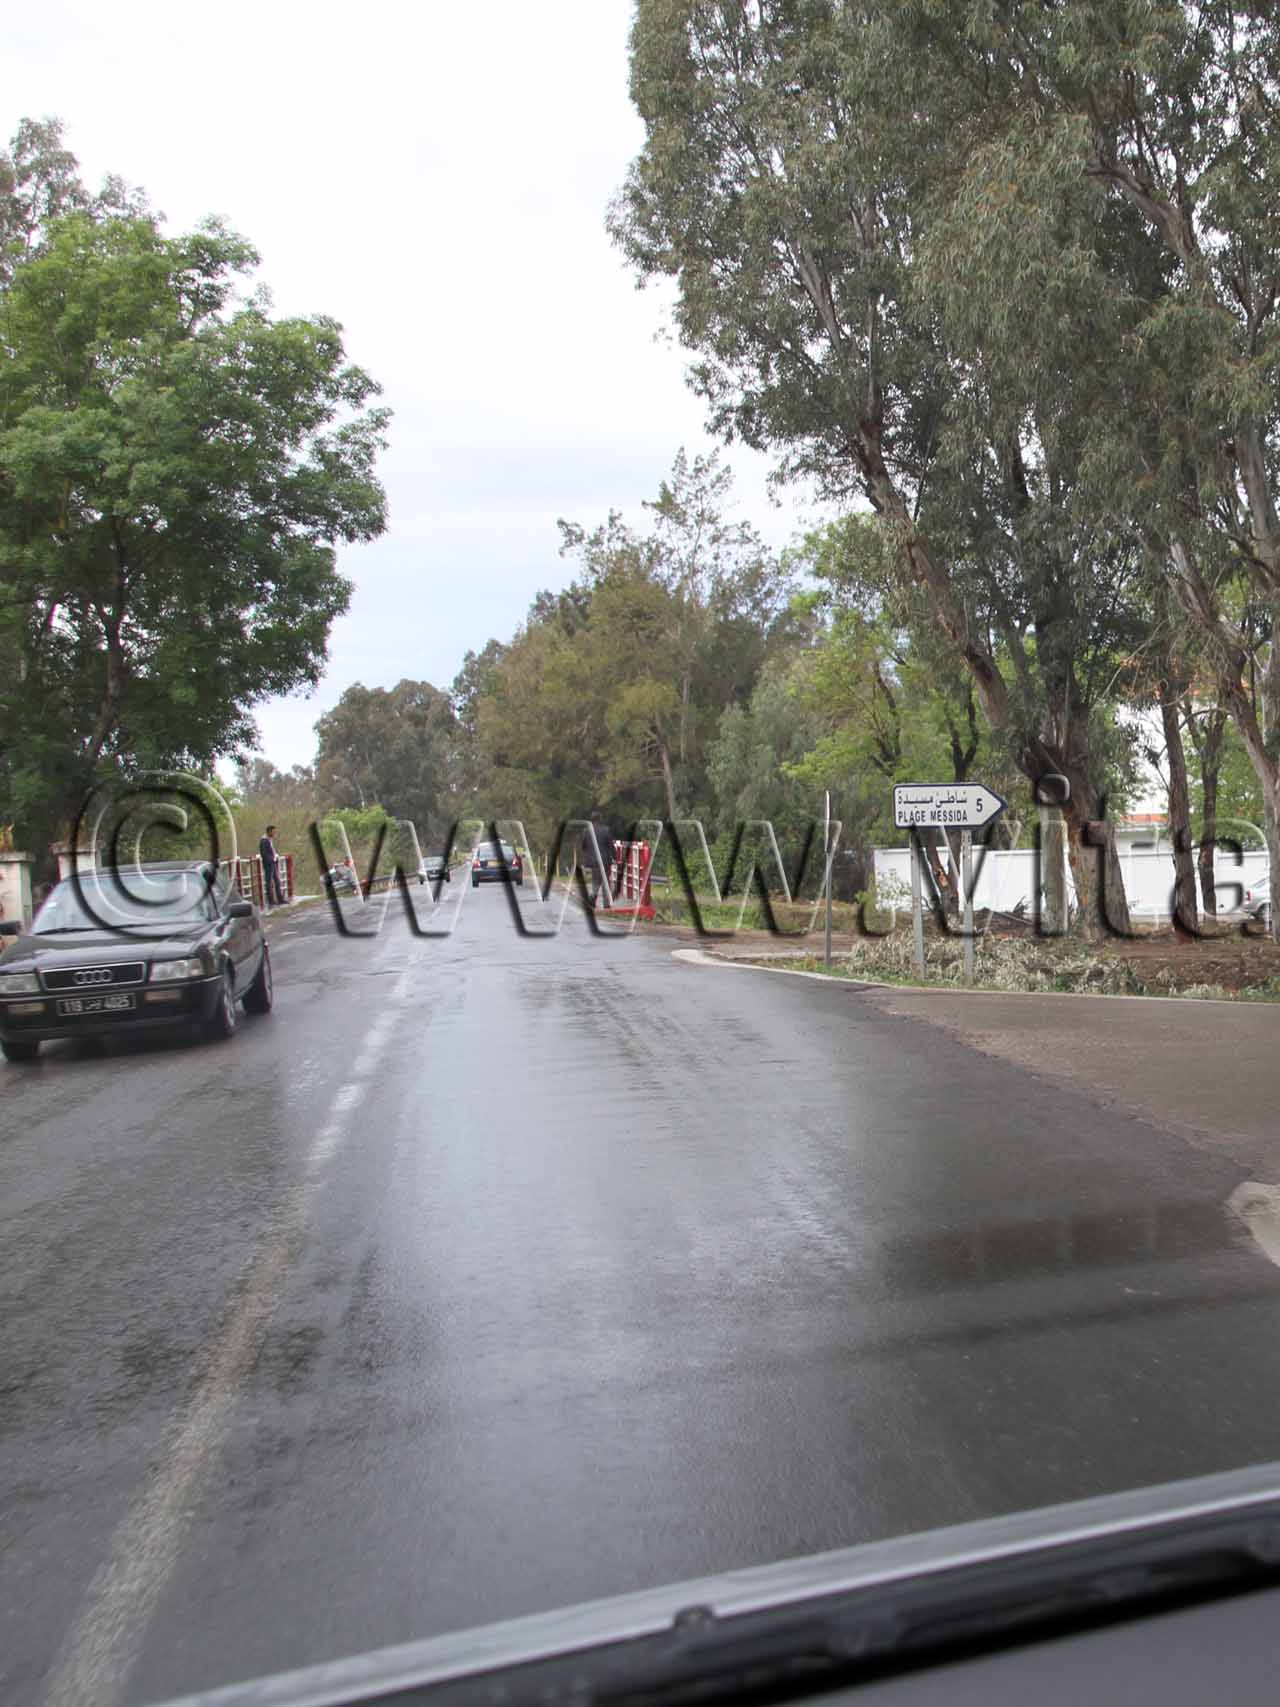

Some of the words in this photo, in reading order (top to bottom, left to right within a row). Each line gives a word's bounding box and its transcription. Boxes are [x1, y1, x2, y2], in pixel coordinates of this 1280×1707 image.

[976, 798, 983, 812] 5
[898, 810, 926, 823] PLAGE
[930, 809, 968, 822] MESSIDA
